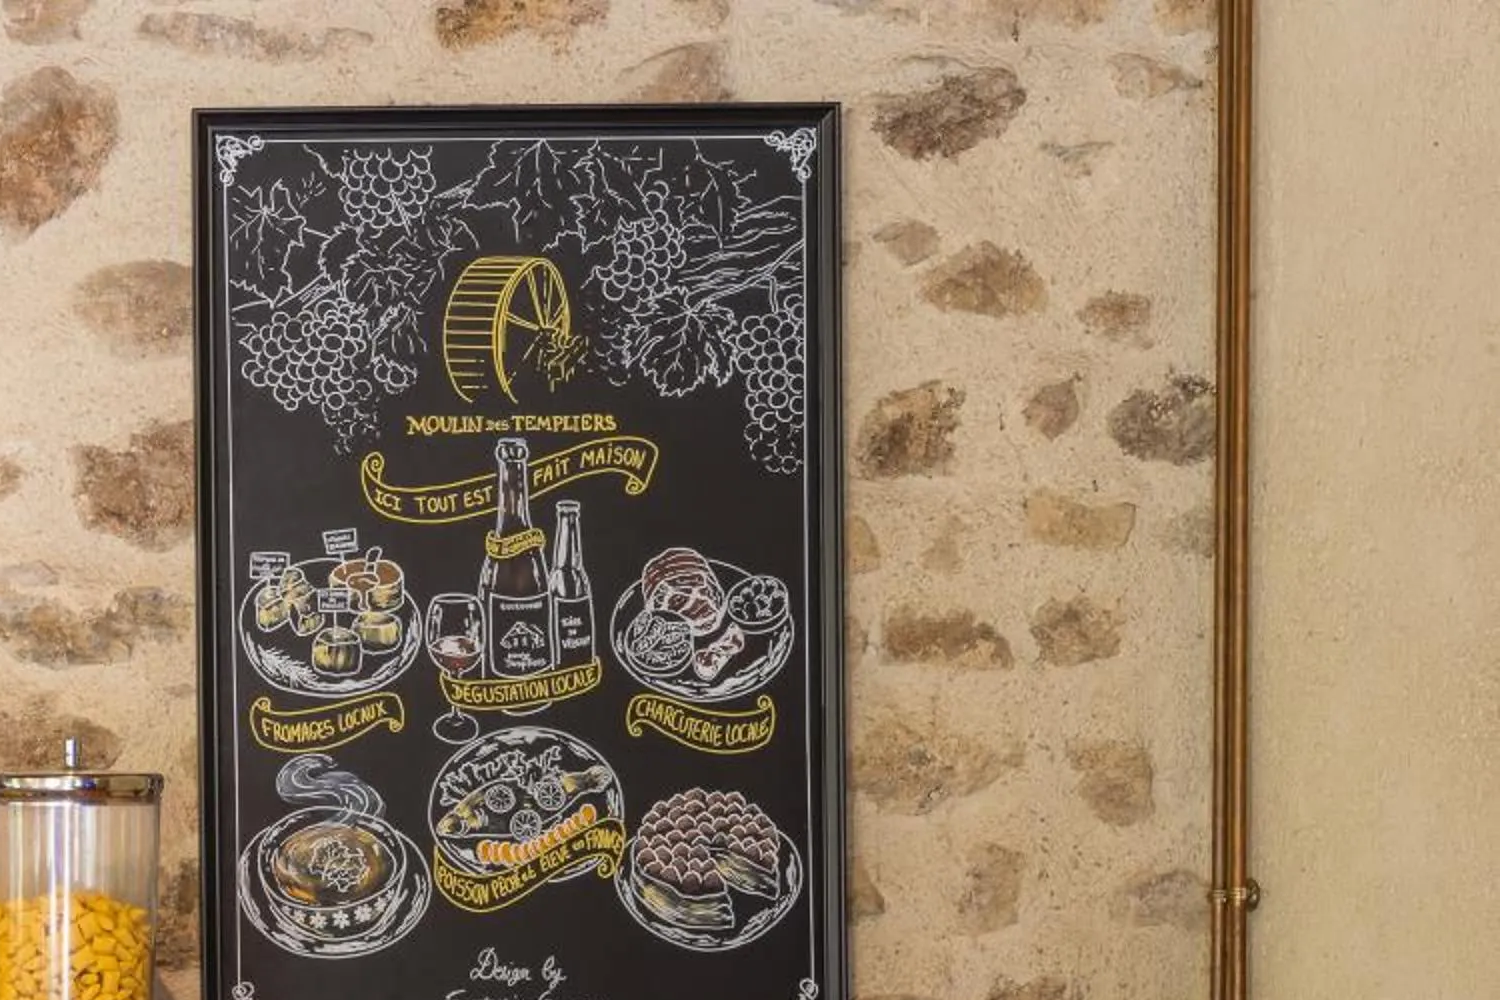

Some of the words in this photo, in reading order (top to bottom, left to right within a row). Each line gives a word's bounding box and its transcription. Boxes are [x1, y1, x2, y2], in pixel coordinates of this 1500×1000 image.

[406, 415, 484, 436] MOULIN
[511, 413, 618, 433] TEMPLIERS
[374, 487, 402, 512] ICI
[415, 493, 458, 514] TOUT
[463, 485, 493, 508] EST
[551, 667, 595, 695] LOCALE
[261, 717, 335, 743] FROMAGES
[338, 701, 387, 732] LOCAUX
[635, 699, 722, 747] CHARCUTERIE
[725, 716, 770, 746] LOCALE
[438, 865, 490, 906] POISSON
[469, 947, 533, 987] Design
[541, 955, 568, 989] by
